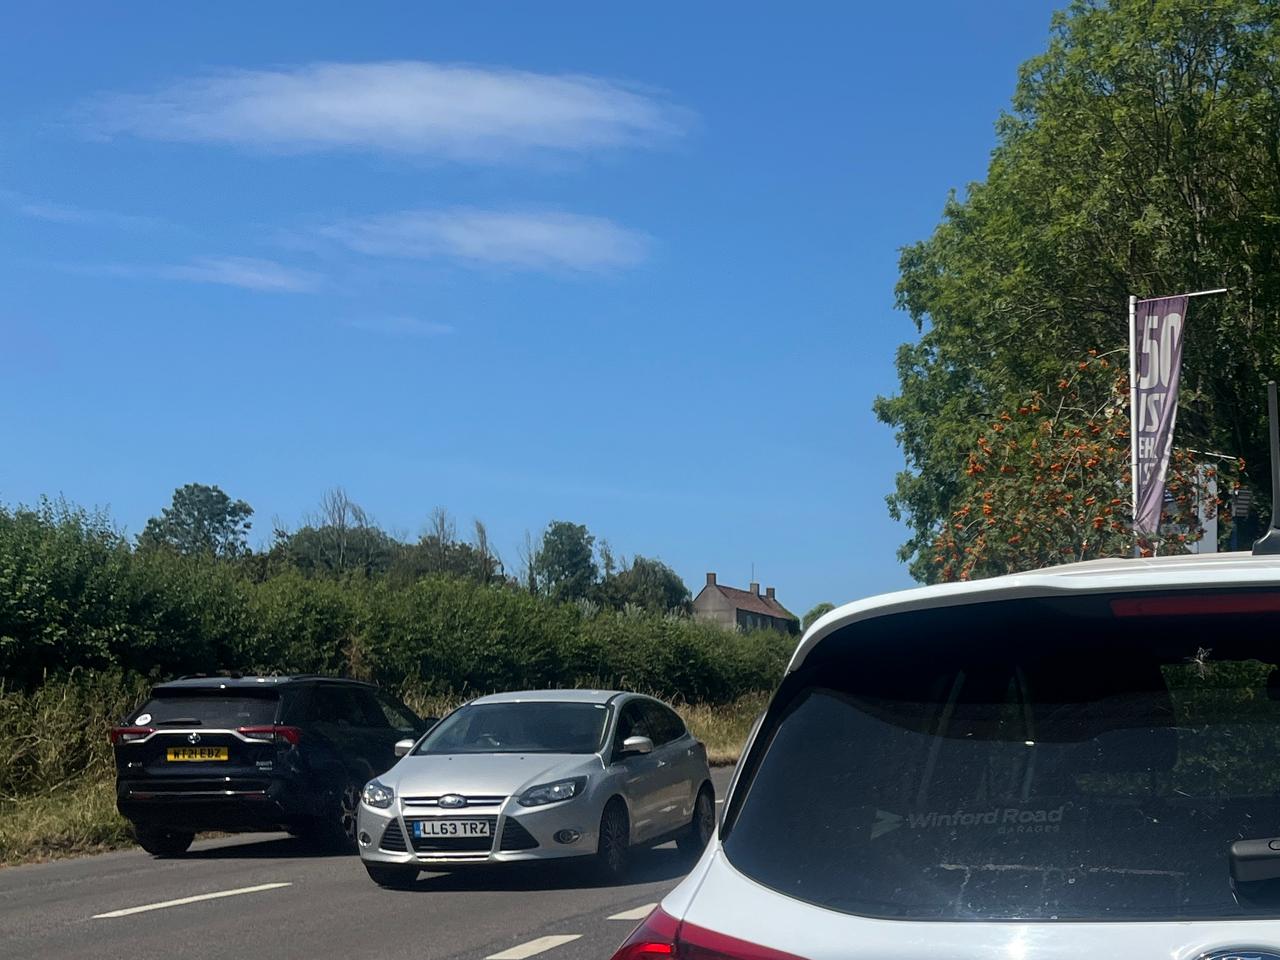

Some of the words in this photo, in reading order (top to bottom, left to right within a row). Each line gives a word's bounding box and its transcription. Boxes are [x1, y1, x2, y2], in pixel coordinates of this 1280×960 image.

[906, 808, 999, 829] Winford
[1002, 806, 1065, 824] Road
[422, 822, 457, 835] LL63
[461, 822, 488, 835] TRZ
